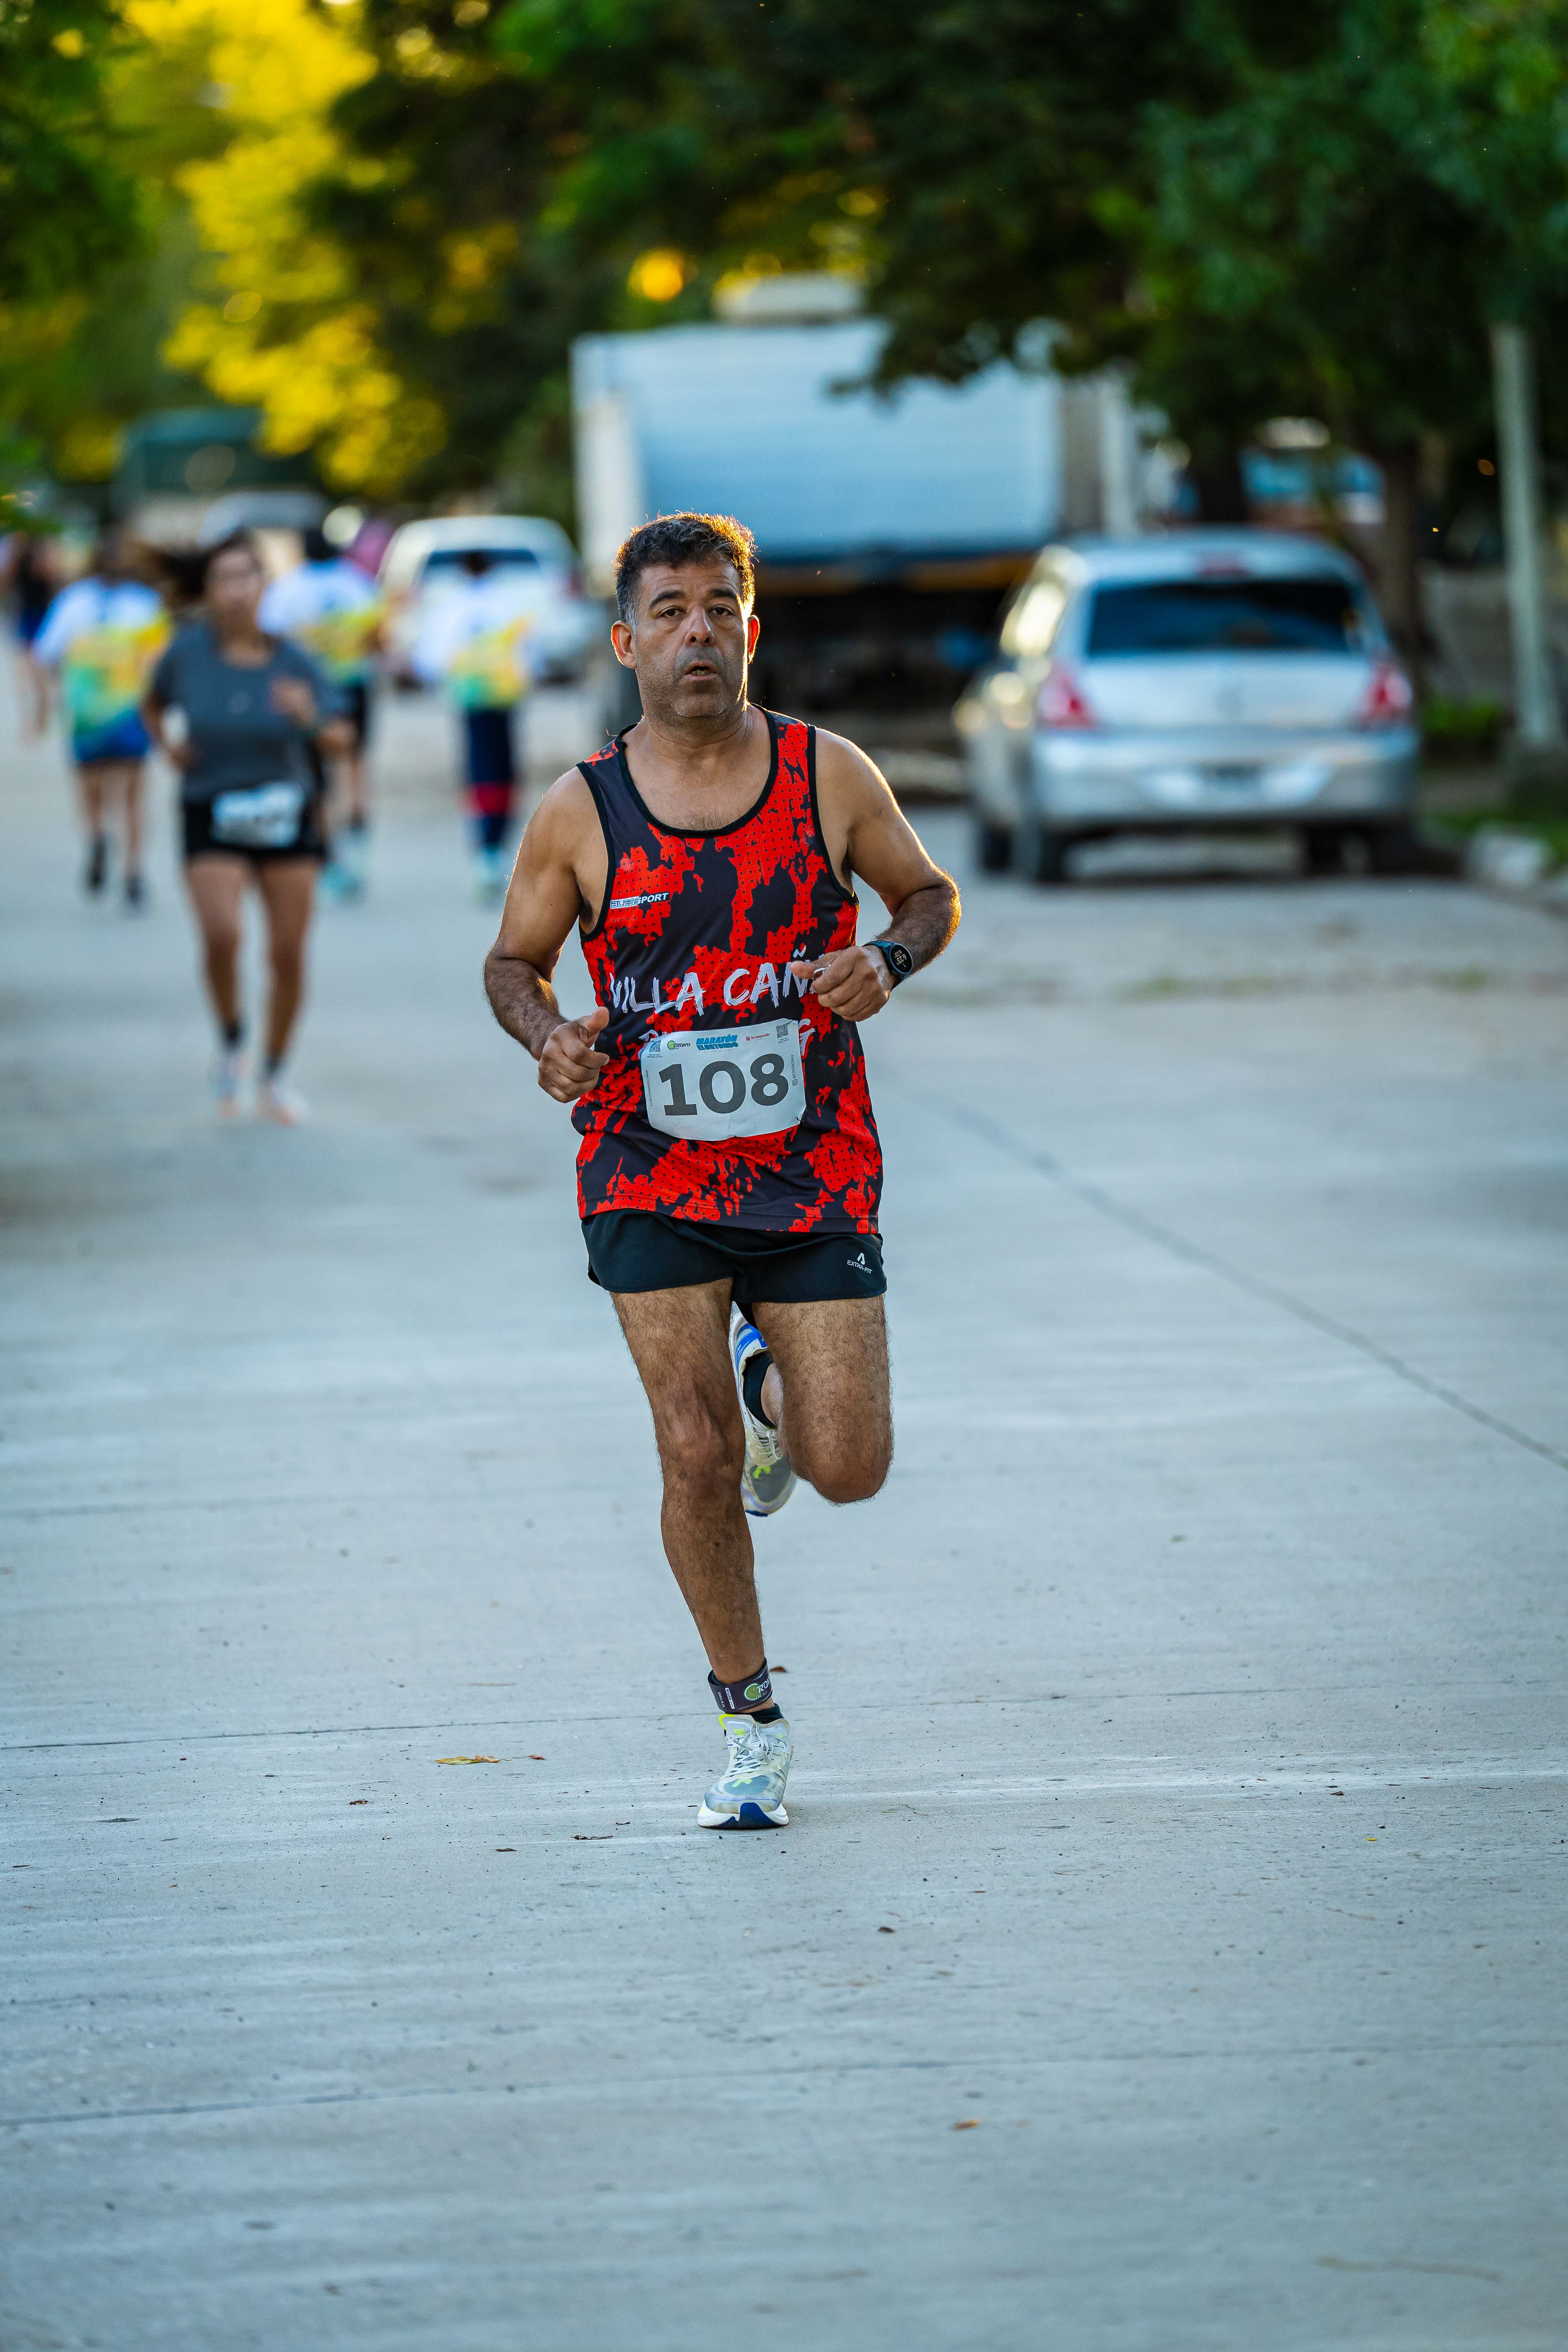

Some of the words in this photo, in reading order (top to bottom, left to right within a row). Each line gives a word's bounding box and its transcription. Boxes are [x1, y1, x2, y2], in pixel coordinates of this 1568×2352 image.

[610, 972, 706, 1016] VILLA
[723, 945, 821, 1008] CAÑ
[658, 1053, 789, 1116] 108
